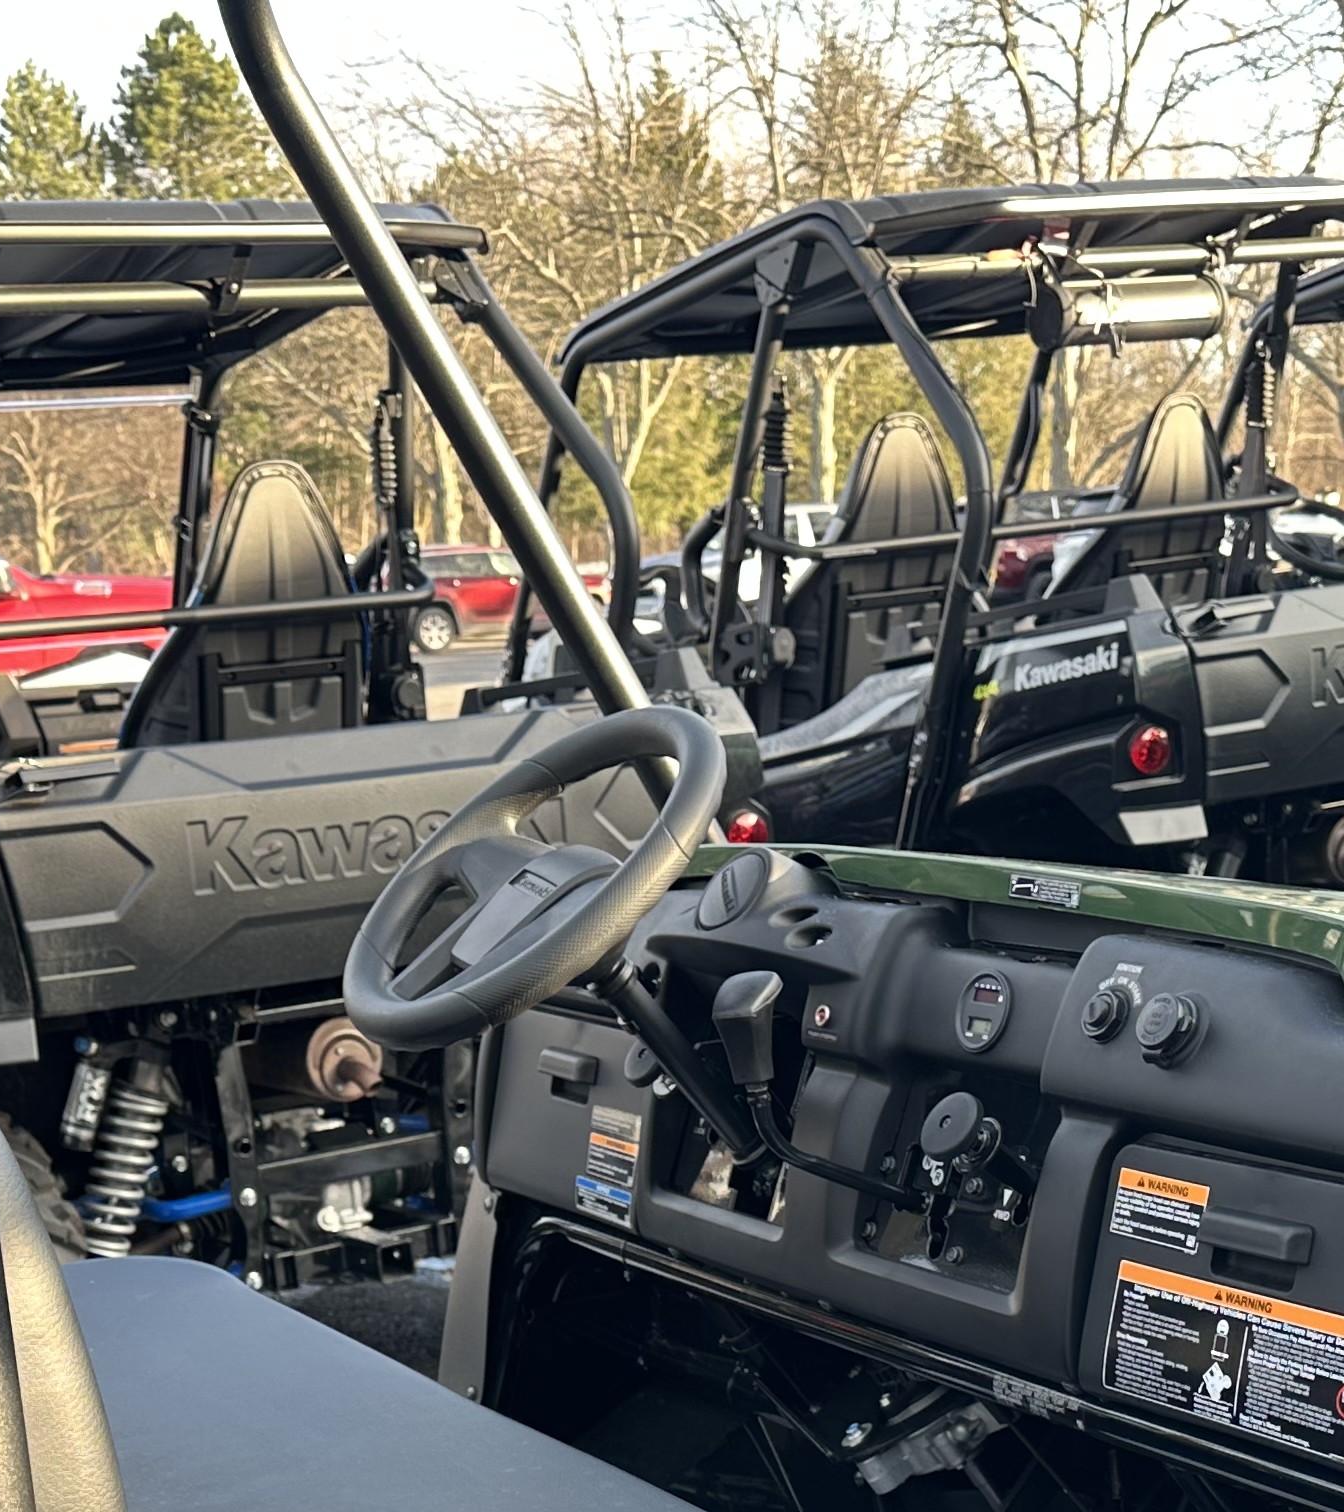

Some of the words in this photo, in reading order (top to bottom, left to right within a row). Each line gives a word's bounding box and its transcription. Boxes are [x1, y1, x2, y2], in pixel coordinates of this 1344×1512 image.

[1014, 642, 1119, 692] Kawasaki
[1148, 1179, 1189, 1197] WARNING
[1225, 1292, 1272, 1314] WARNING
